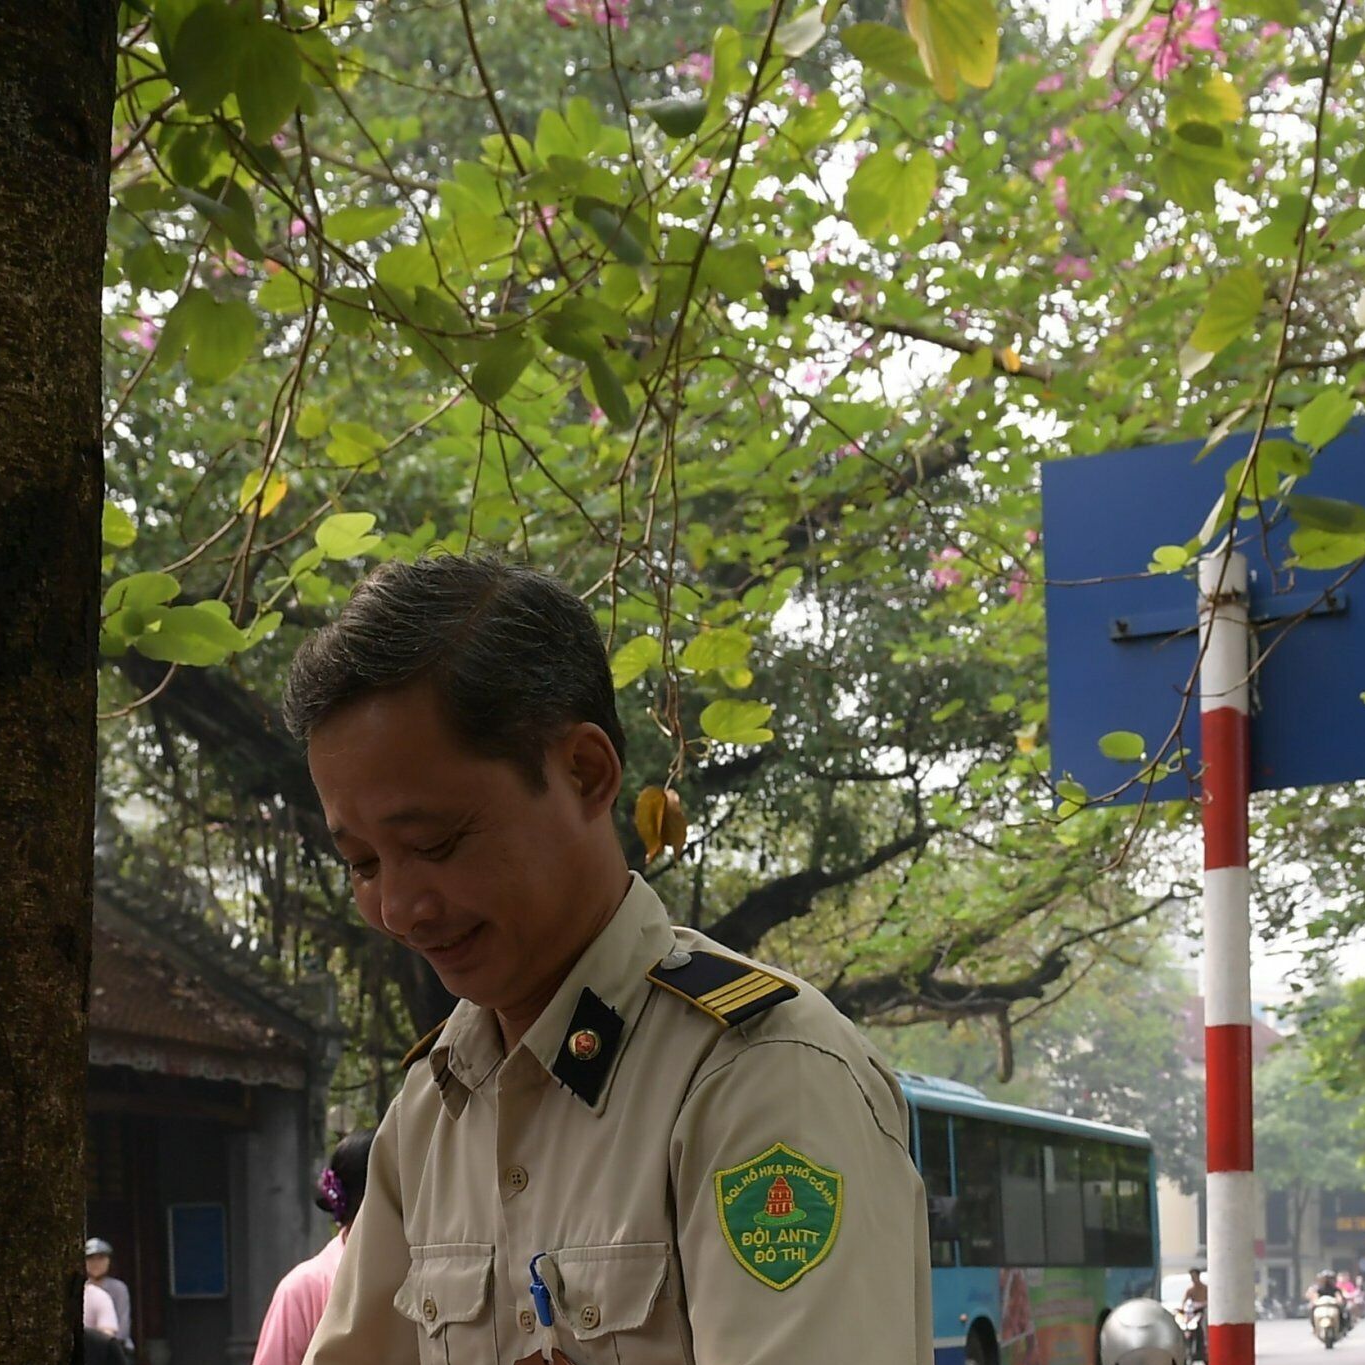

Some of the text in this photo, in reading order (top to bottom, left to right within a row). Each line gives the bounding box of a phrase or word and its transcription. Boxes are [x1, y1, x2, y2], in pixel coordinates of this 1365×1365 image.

[741, 1227, 820, 1247] ĐỘI ANTT
[754, 1246, 807, 1263] ĐÔ THỊ
